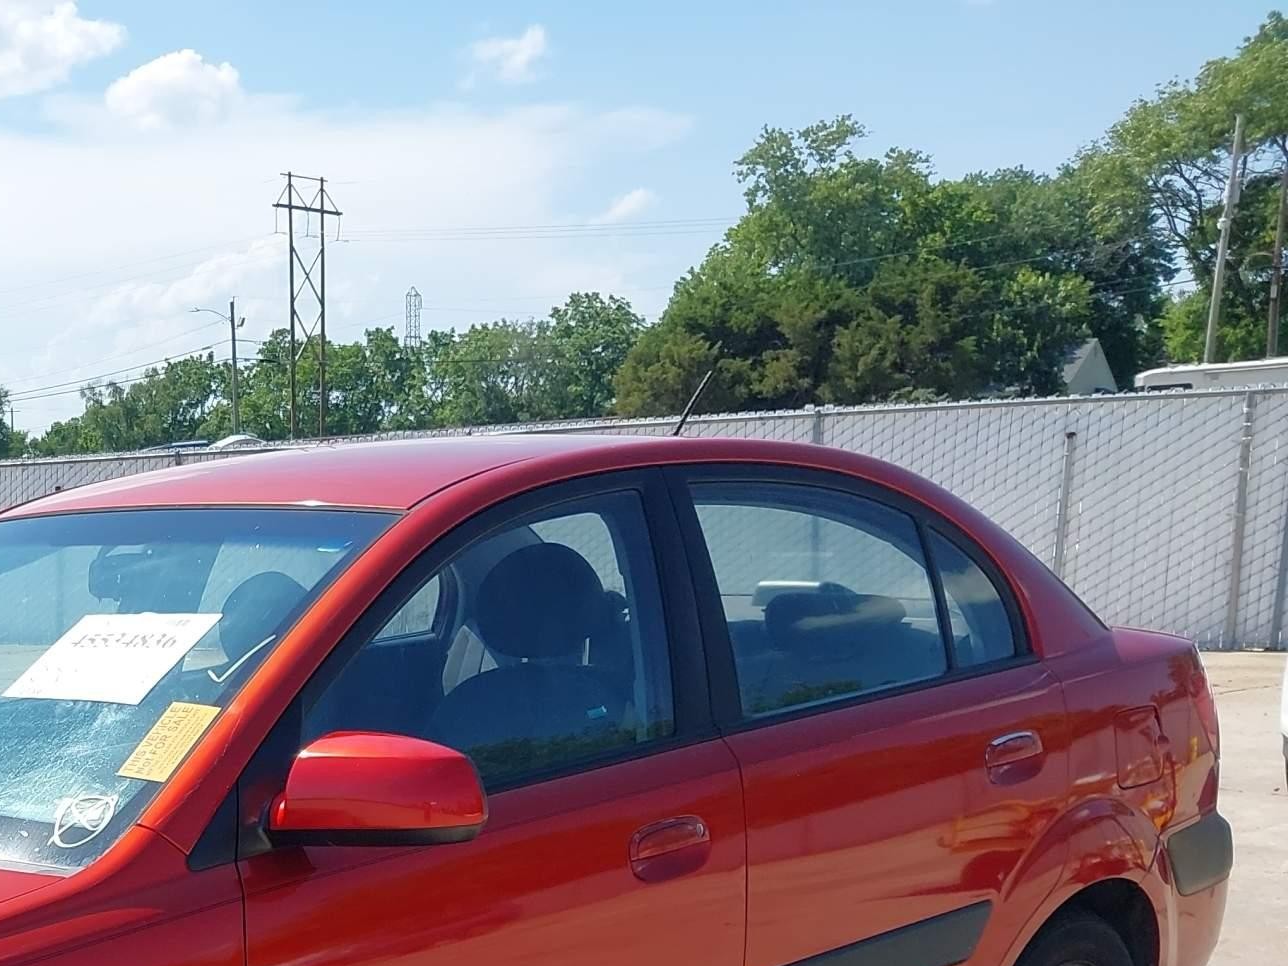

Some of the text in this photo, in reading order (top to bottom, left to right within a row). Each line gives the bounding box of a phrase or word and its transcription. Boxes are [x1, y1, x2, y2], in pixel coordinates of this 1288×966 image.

[143, 706, 180, 748] VEHICLE
[151, 734, 172, 755] FOR
[167, 705, 194, 732] SALE
